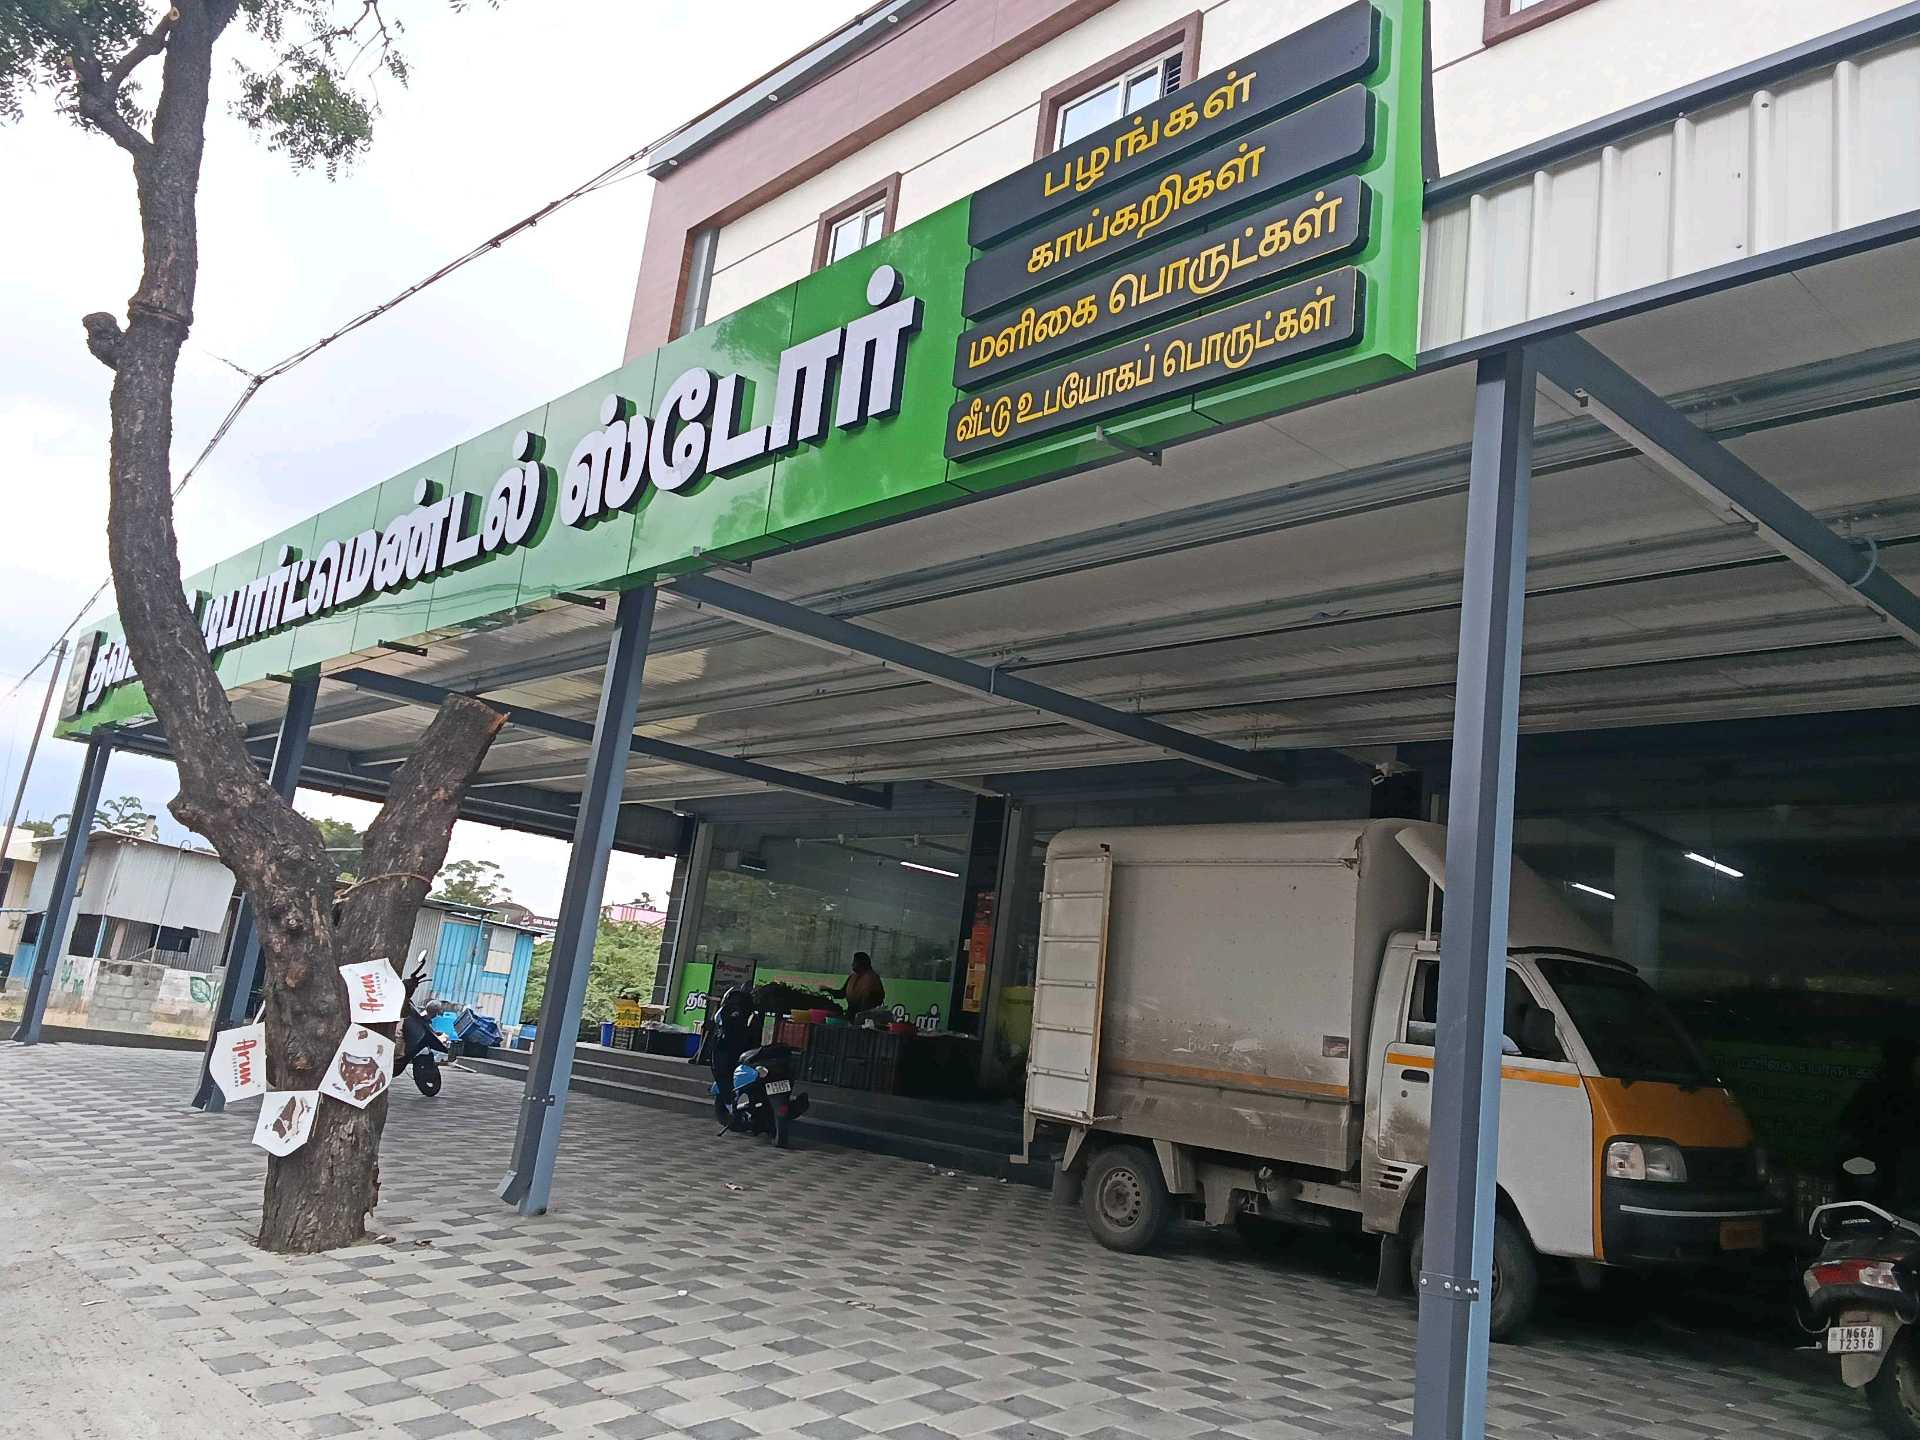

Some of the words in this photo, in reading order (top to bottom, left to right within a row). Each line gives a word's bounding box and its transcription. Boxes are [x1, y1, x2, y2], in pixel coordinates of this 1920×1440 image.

[1044, 70, 1257, 196] பழங்கள்
[1027, 143, 1265, 273] காய்கறிகள்
[968, 294, 1098, 368] மளிகை
[1109, 191, 1342, 313] பொருட்கள்
[560, 264, 920, 528] ஸ்டோர்
[956, 398, 1010, 442] வீட்டு
[1162, 286, 1335, 378] பொருட்கள்
[360, 973, 384, 1013] Arun
[232, 1039, 256, 1085] Arun
